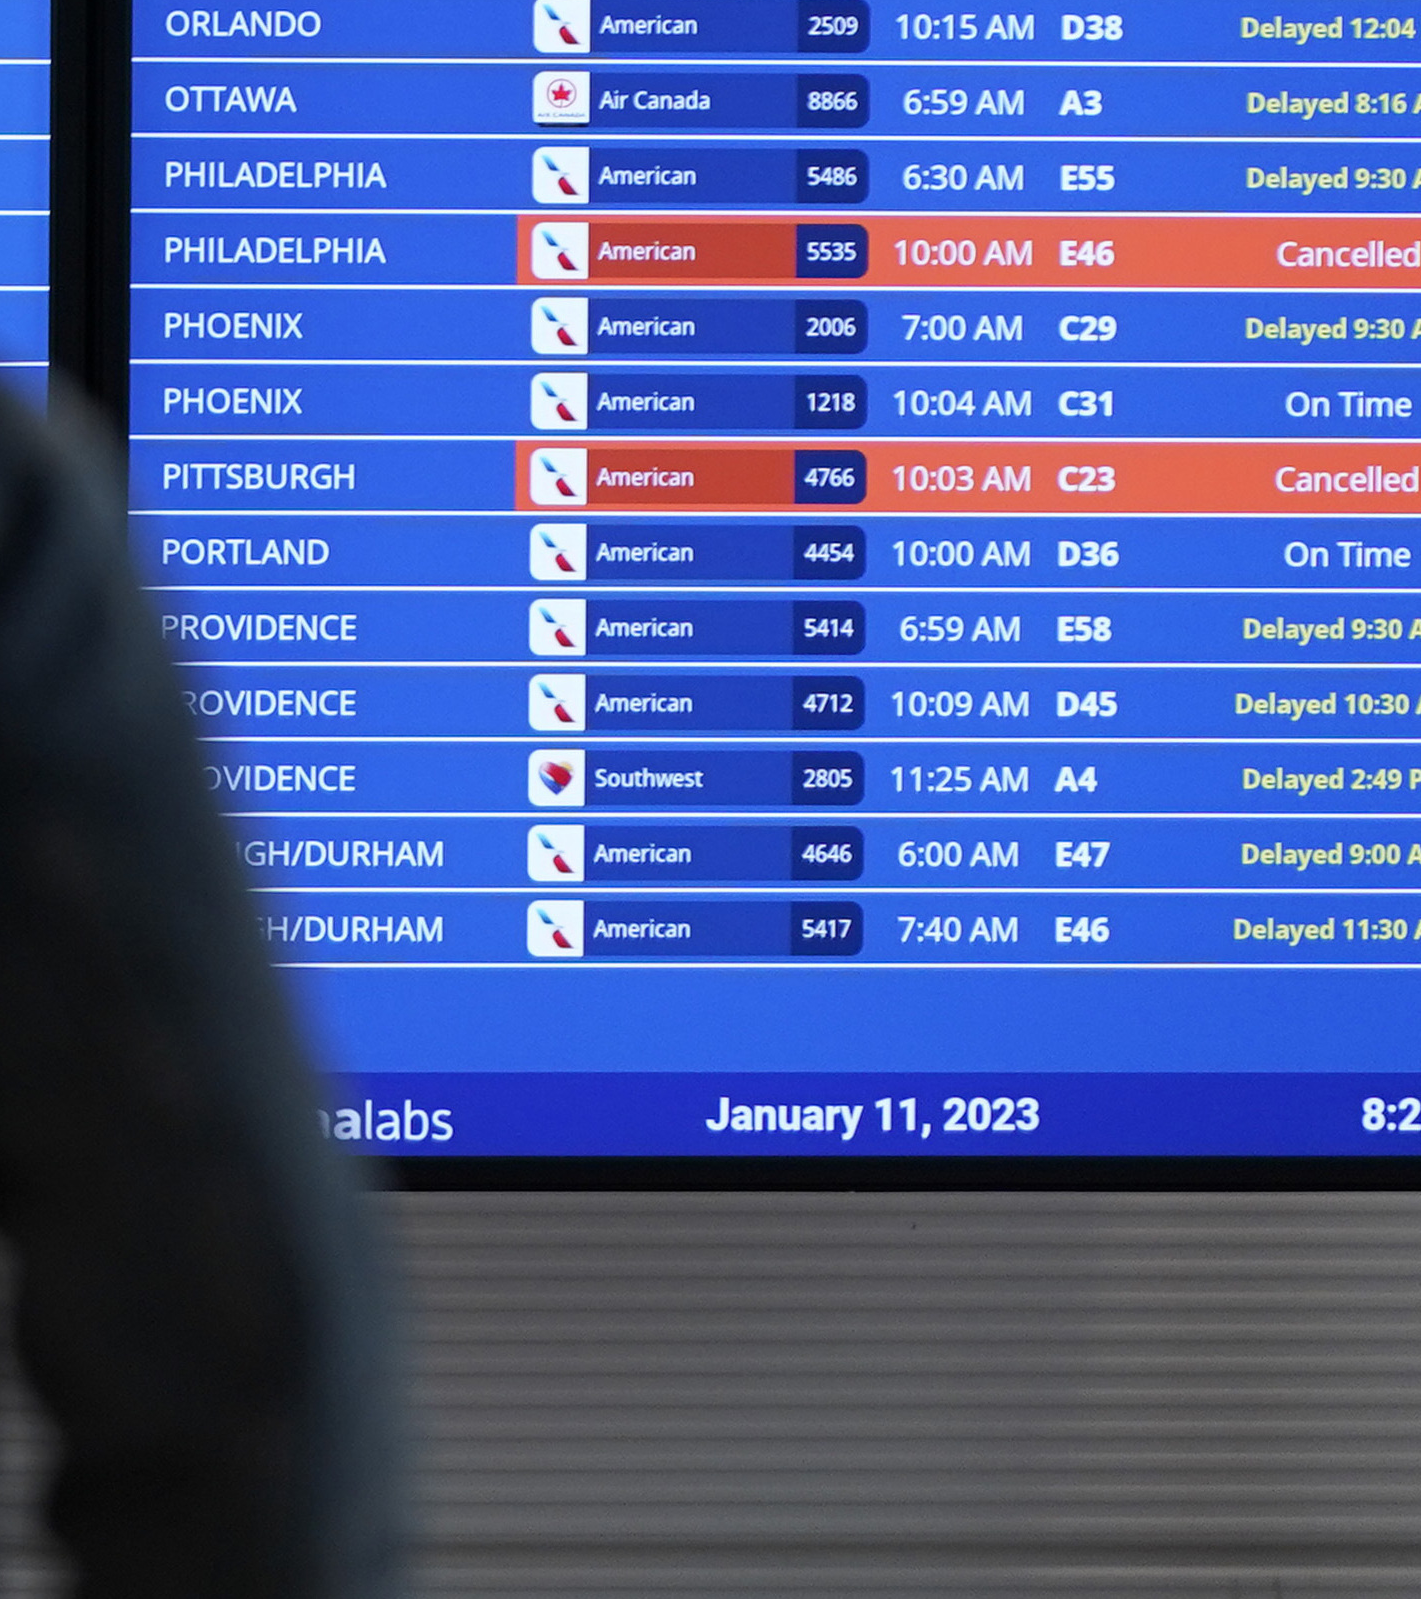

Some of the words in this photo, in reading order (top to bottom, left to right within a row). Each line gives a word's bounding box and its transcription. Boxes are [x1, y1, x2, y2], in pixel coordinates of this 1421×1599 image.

[164, 85, 298, 113] OTTAWA
[598, 89, 630, 110] Air
[632, 88, 711, 110] Canada
[807, 91, 858, 111] 8866
[903, 89, 968, 116] 6:59
[974, 89, 1025, 116] AM
[1058, 89, 1103, 116] A3
[1246, 90, 1349, 121] Delayed
[1354, 92, 1408, 115] 8:16
[163, 463, 355, 490] PITTSBURGH
[596, 467, 695, 487] American
[804, 467, 855, 487] 4766
[892, 465, 975, 492] 10:03
[981, 465, 1031, 492] AM
[1057, 465, 1116, 492] C23
[1275, 465, 1420, 493] Cancelled
[705, 1096, 864, 1142] January
[874, 1097, 932, 1140] 11,
[942, 1096, 1040, 1132] 2023
